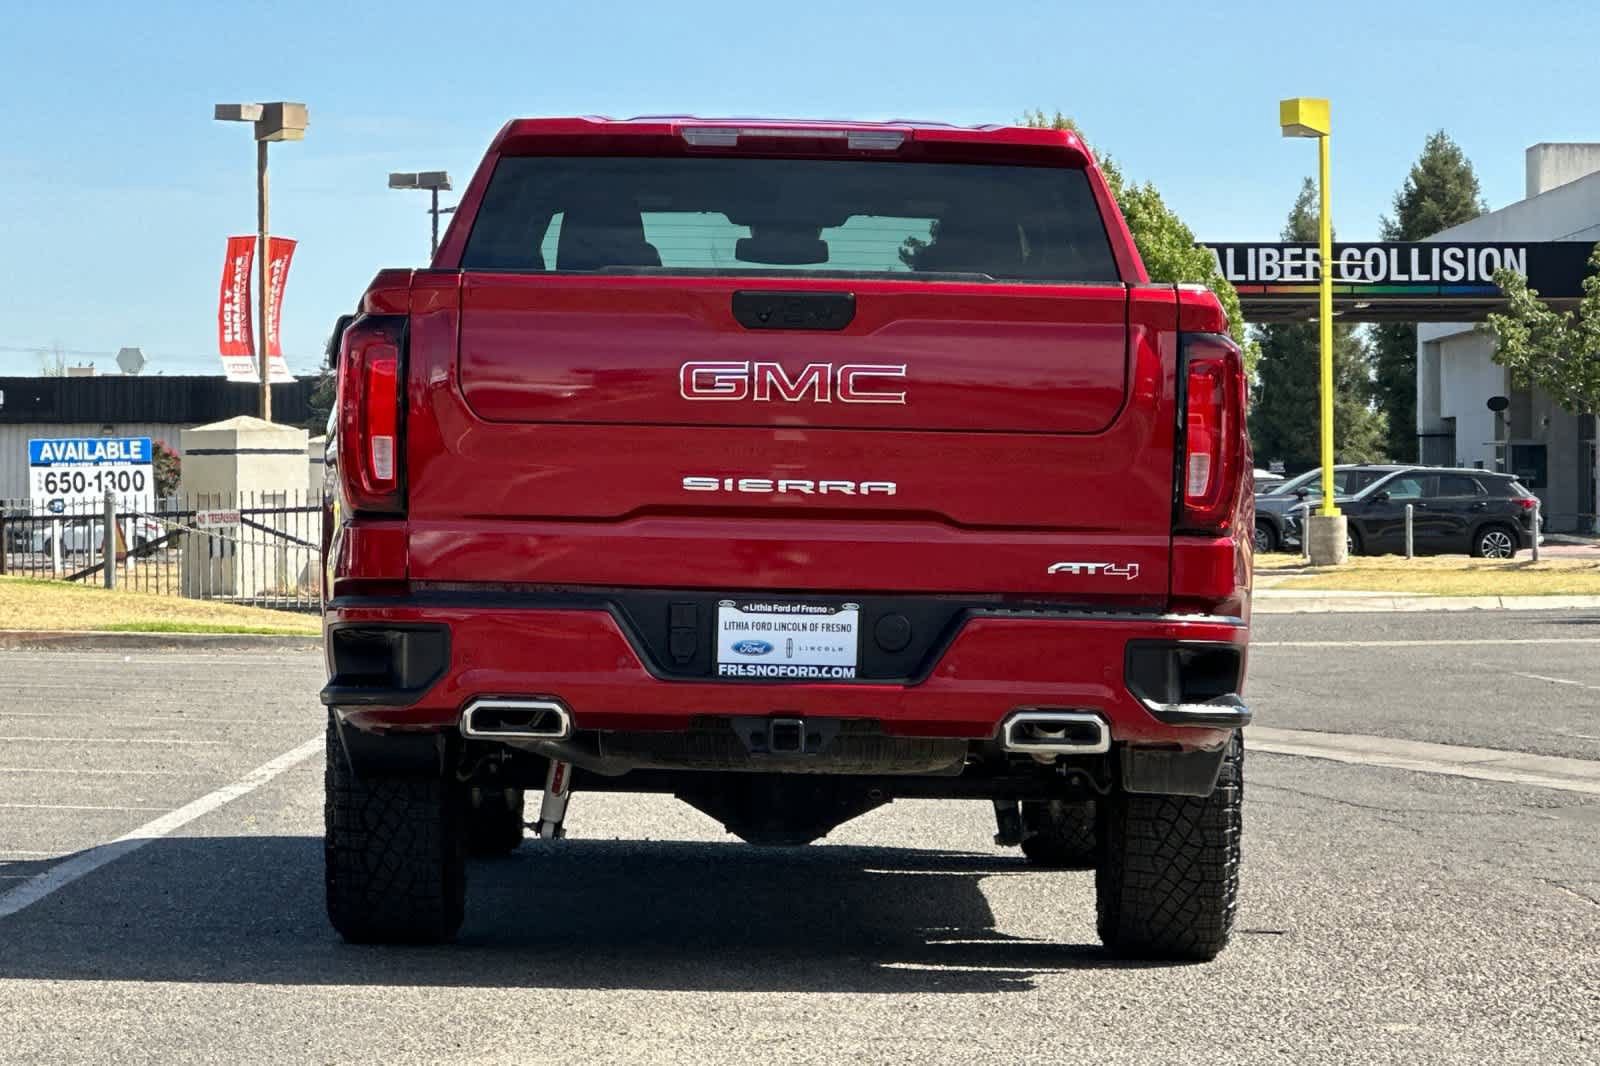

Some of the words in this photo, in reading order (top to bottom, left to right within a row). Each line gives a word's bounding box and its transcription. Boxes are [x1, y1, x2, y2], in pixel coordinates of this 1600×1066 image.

[1339, 247, 1527, 282] COLLISION
[680, 360, 907, 404] GMC
[40, 440, 142, 461] AVAILABLE
[683, 476, 897, 496] SIERRA
[1047, 562, 1139, 580] AT4
[750, 603, 771, 612] Lithia
[773, 604, 791, 613] Ford
[792, 605, 801, 613] of
[802, 605, 827, 613] Fresno
[724, 621, 750, 631] LITHIA
[751, 622, 772, 631] FORD
[774, 622, 807, 632] LINCOLN
[809, 623, 819, 632] OF
[821, 623, 851, 633] FRESNO
[739, 642, 765, 653] Ford
[718, 664, 856, 678] FRESNOFORD.COM
